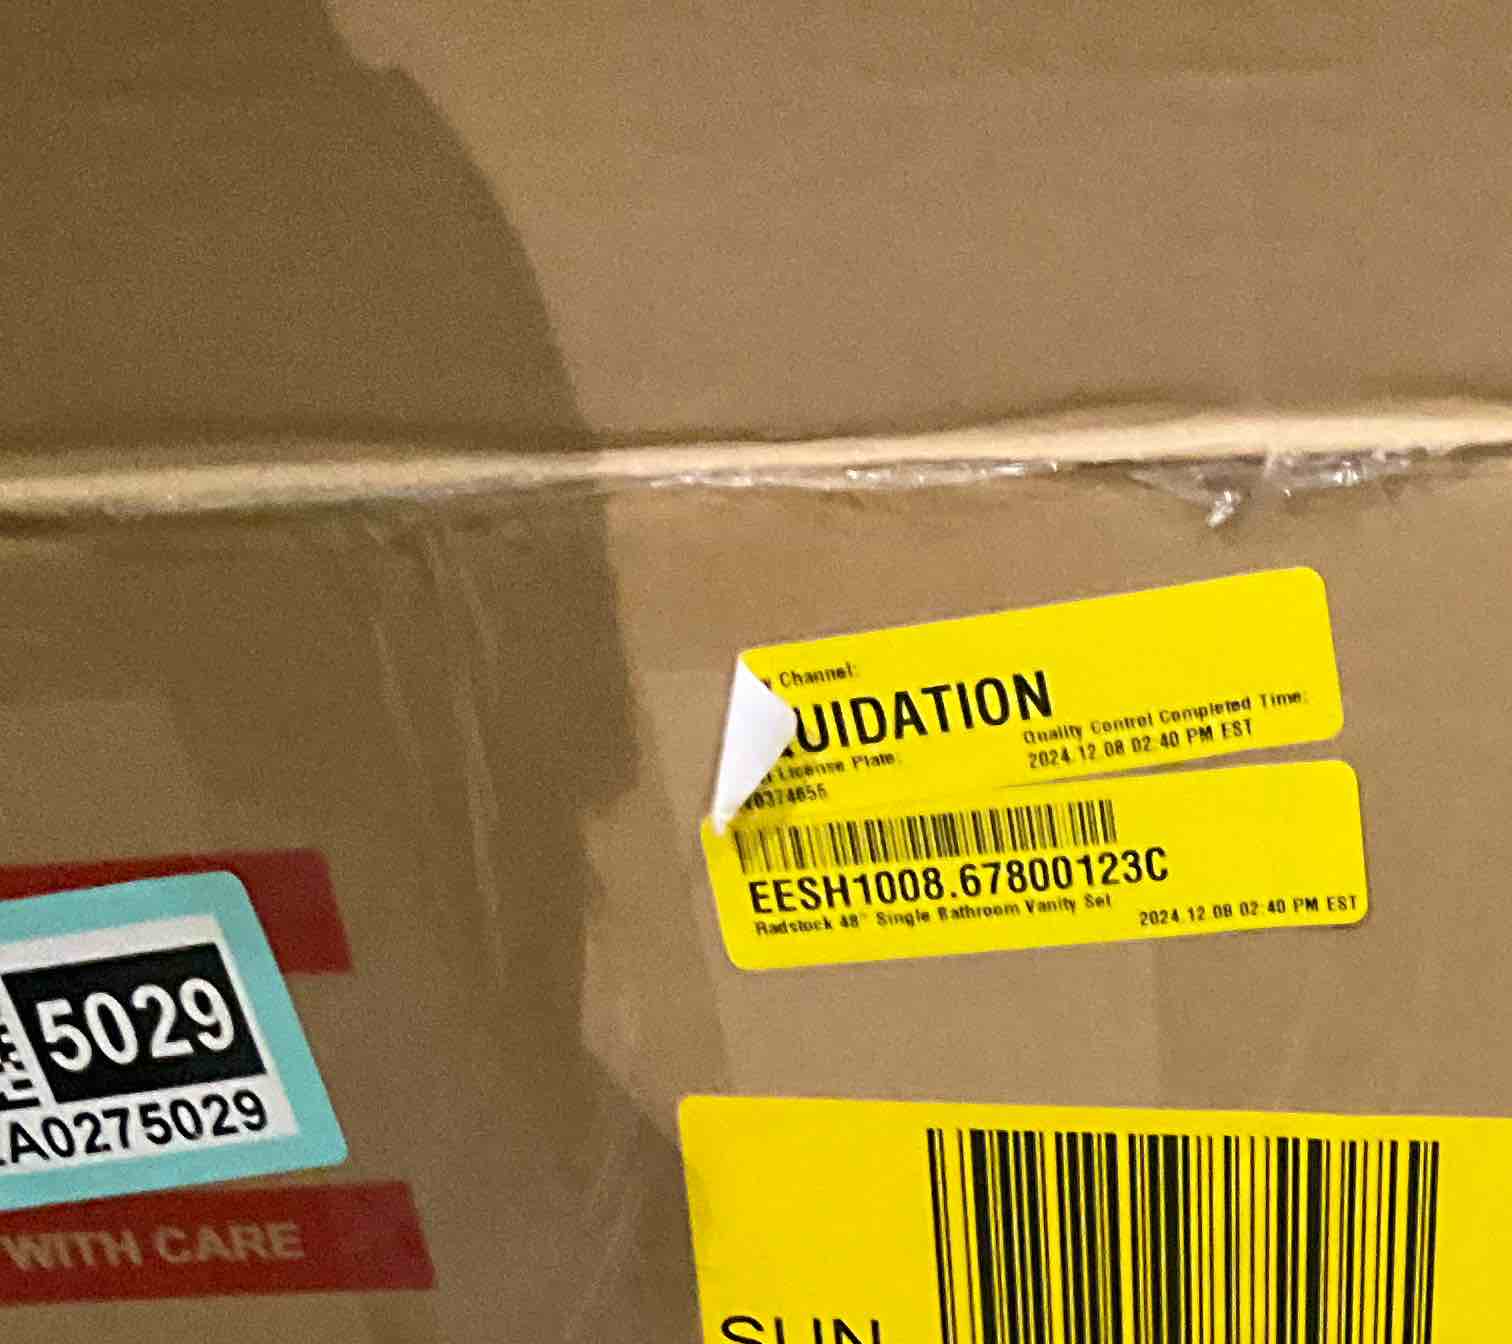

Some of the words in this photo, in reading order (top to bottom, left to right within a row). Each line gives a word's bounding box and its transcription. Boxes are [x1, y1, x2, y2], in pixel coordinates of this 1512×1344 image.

[780, 670, 1053, 758] UIDATION
[1024, 723, 1083, 745] Quality
[1091, 713, 1153, 734] Control
[1159, 697, 1251, 725] Completed
[1187, 724, 1214, 745] PM
[1222, 718, 1253, 739] EST
[749, 846, 1169, 915] EESH1008.67800123C
[1294, 896, 1319, 913] PM
[1327, 895, 1358, 911] EST
[877, 908, 930, 928] Single
[938, 902, 1020, 922] Bathroom
[1025, 897, 1076, 916] Vanity
[1085, 892, 1112, 910] Set
[36, 977, 236, 1072] 5029
[0, 1089, 268, 1167] A0275029
[0, 1230, 142, 1271] WITH
[153, 1221, 305, 1264] CARE
